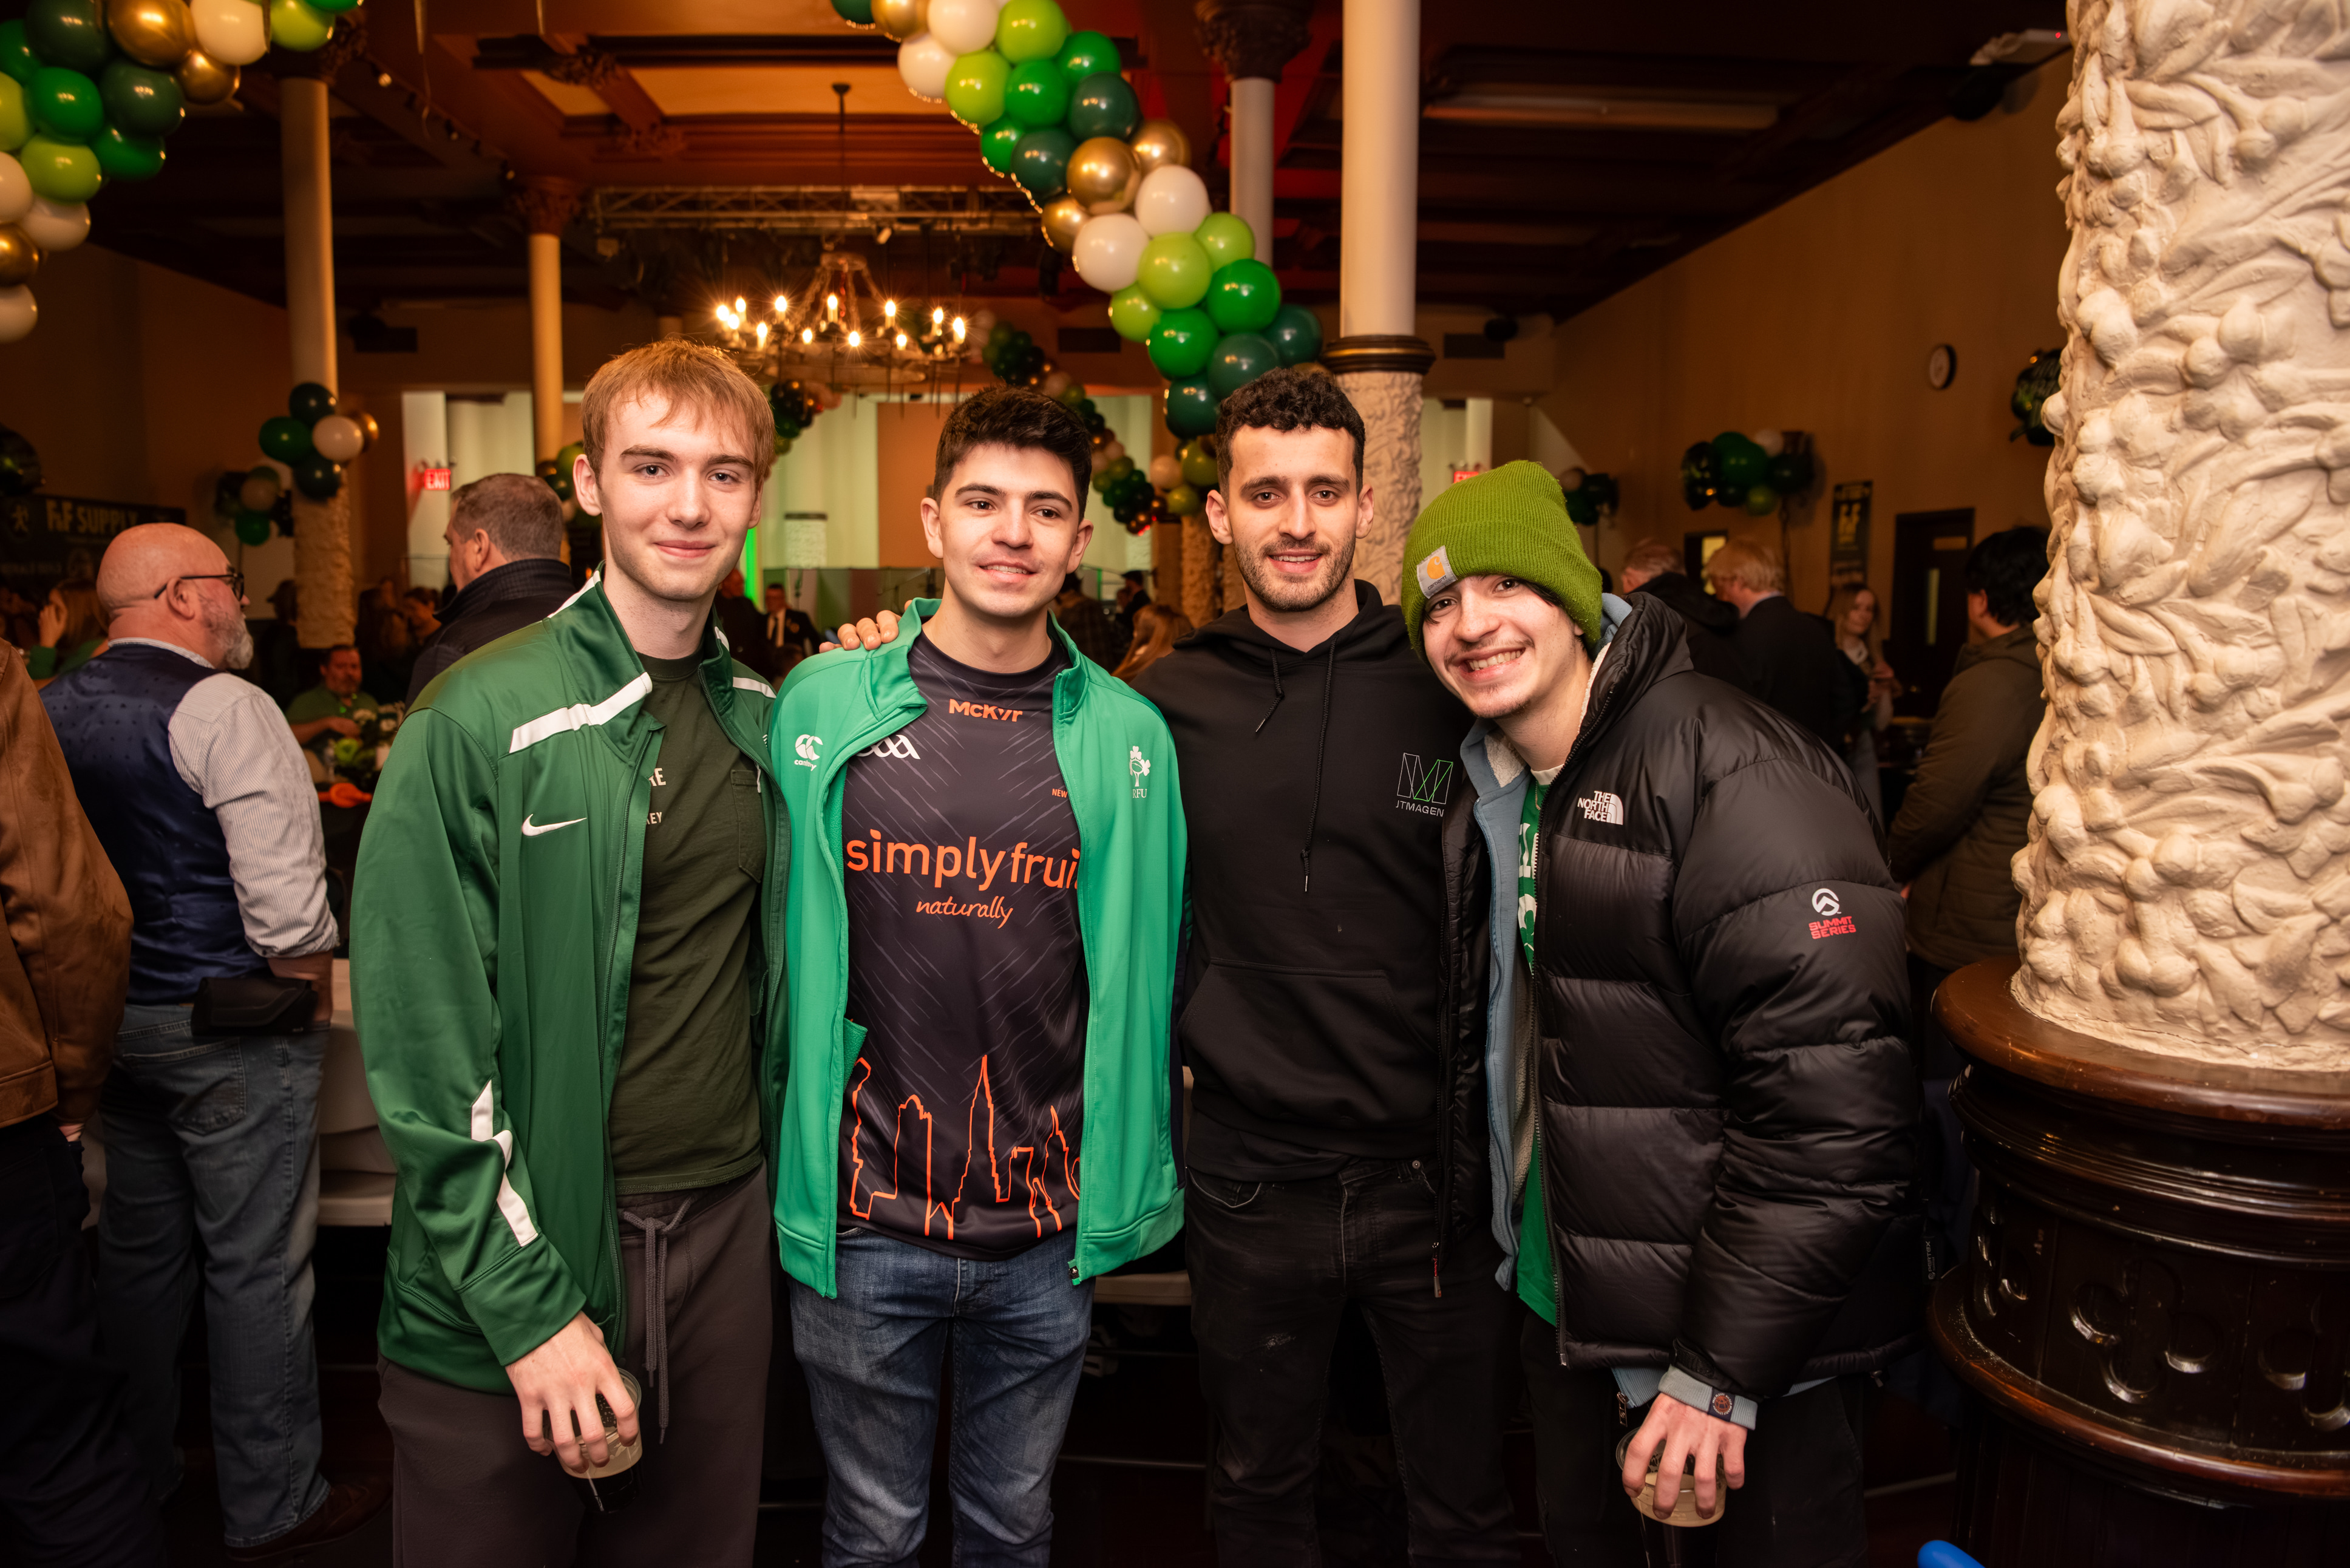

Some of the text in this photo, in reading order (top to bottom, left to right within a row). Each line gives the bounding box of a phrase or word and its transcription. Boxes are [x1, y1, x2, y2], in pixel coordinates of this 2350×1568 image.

[426, 472, 449, 489] EXIT
[76, 506, 139, 535] SUPPLY
[1428, 575, 1447, 589] carhartt
[1052, 788, 1068, 798] NEW
[1594, 790, 1611, 803] THE
[1396, 800, 1444, 818] JTMAGEN
[1577, 797, 1609, 812] NORTH
[1584, 809, 1607, 823] FACE
[916, 895, 1013, 929] naturally
[1808, 915, 1852, 932] SUMMIT
[1810, 924, 1856, 940] SERIES
